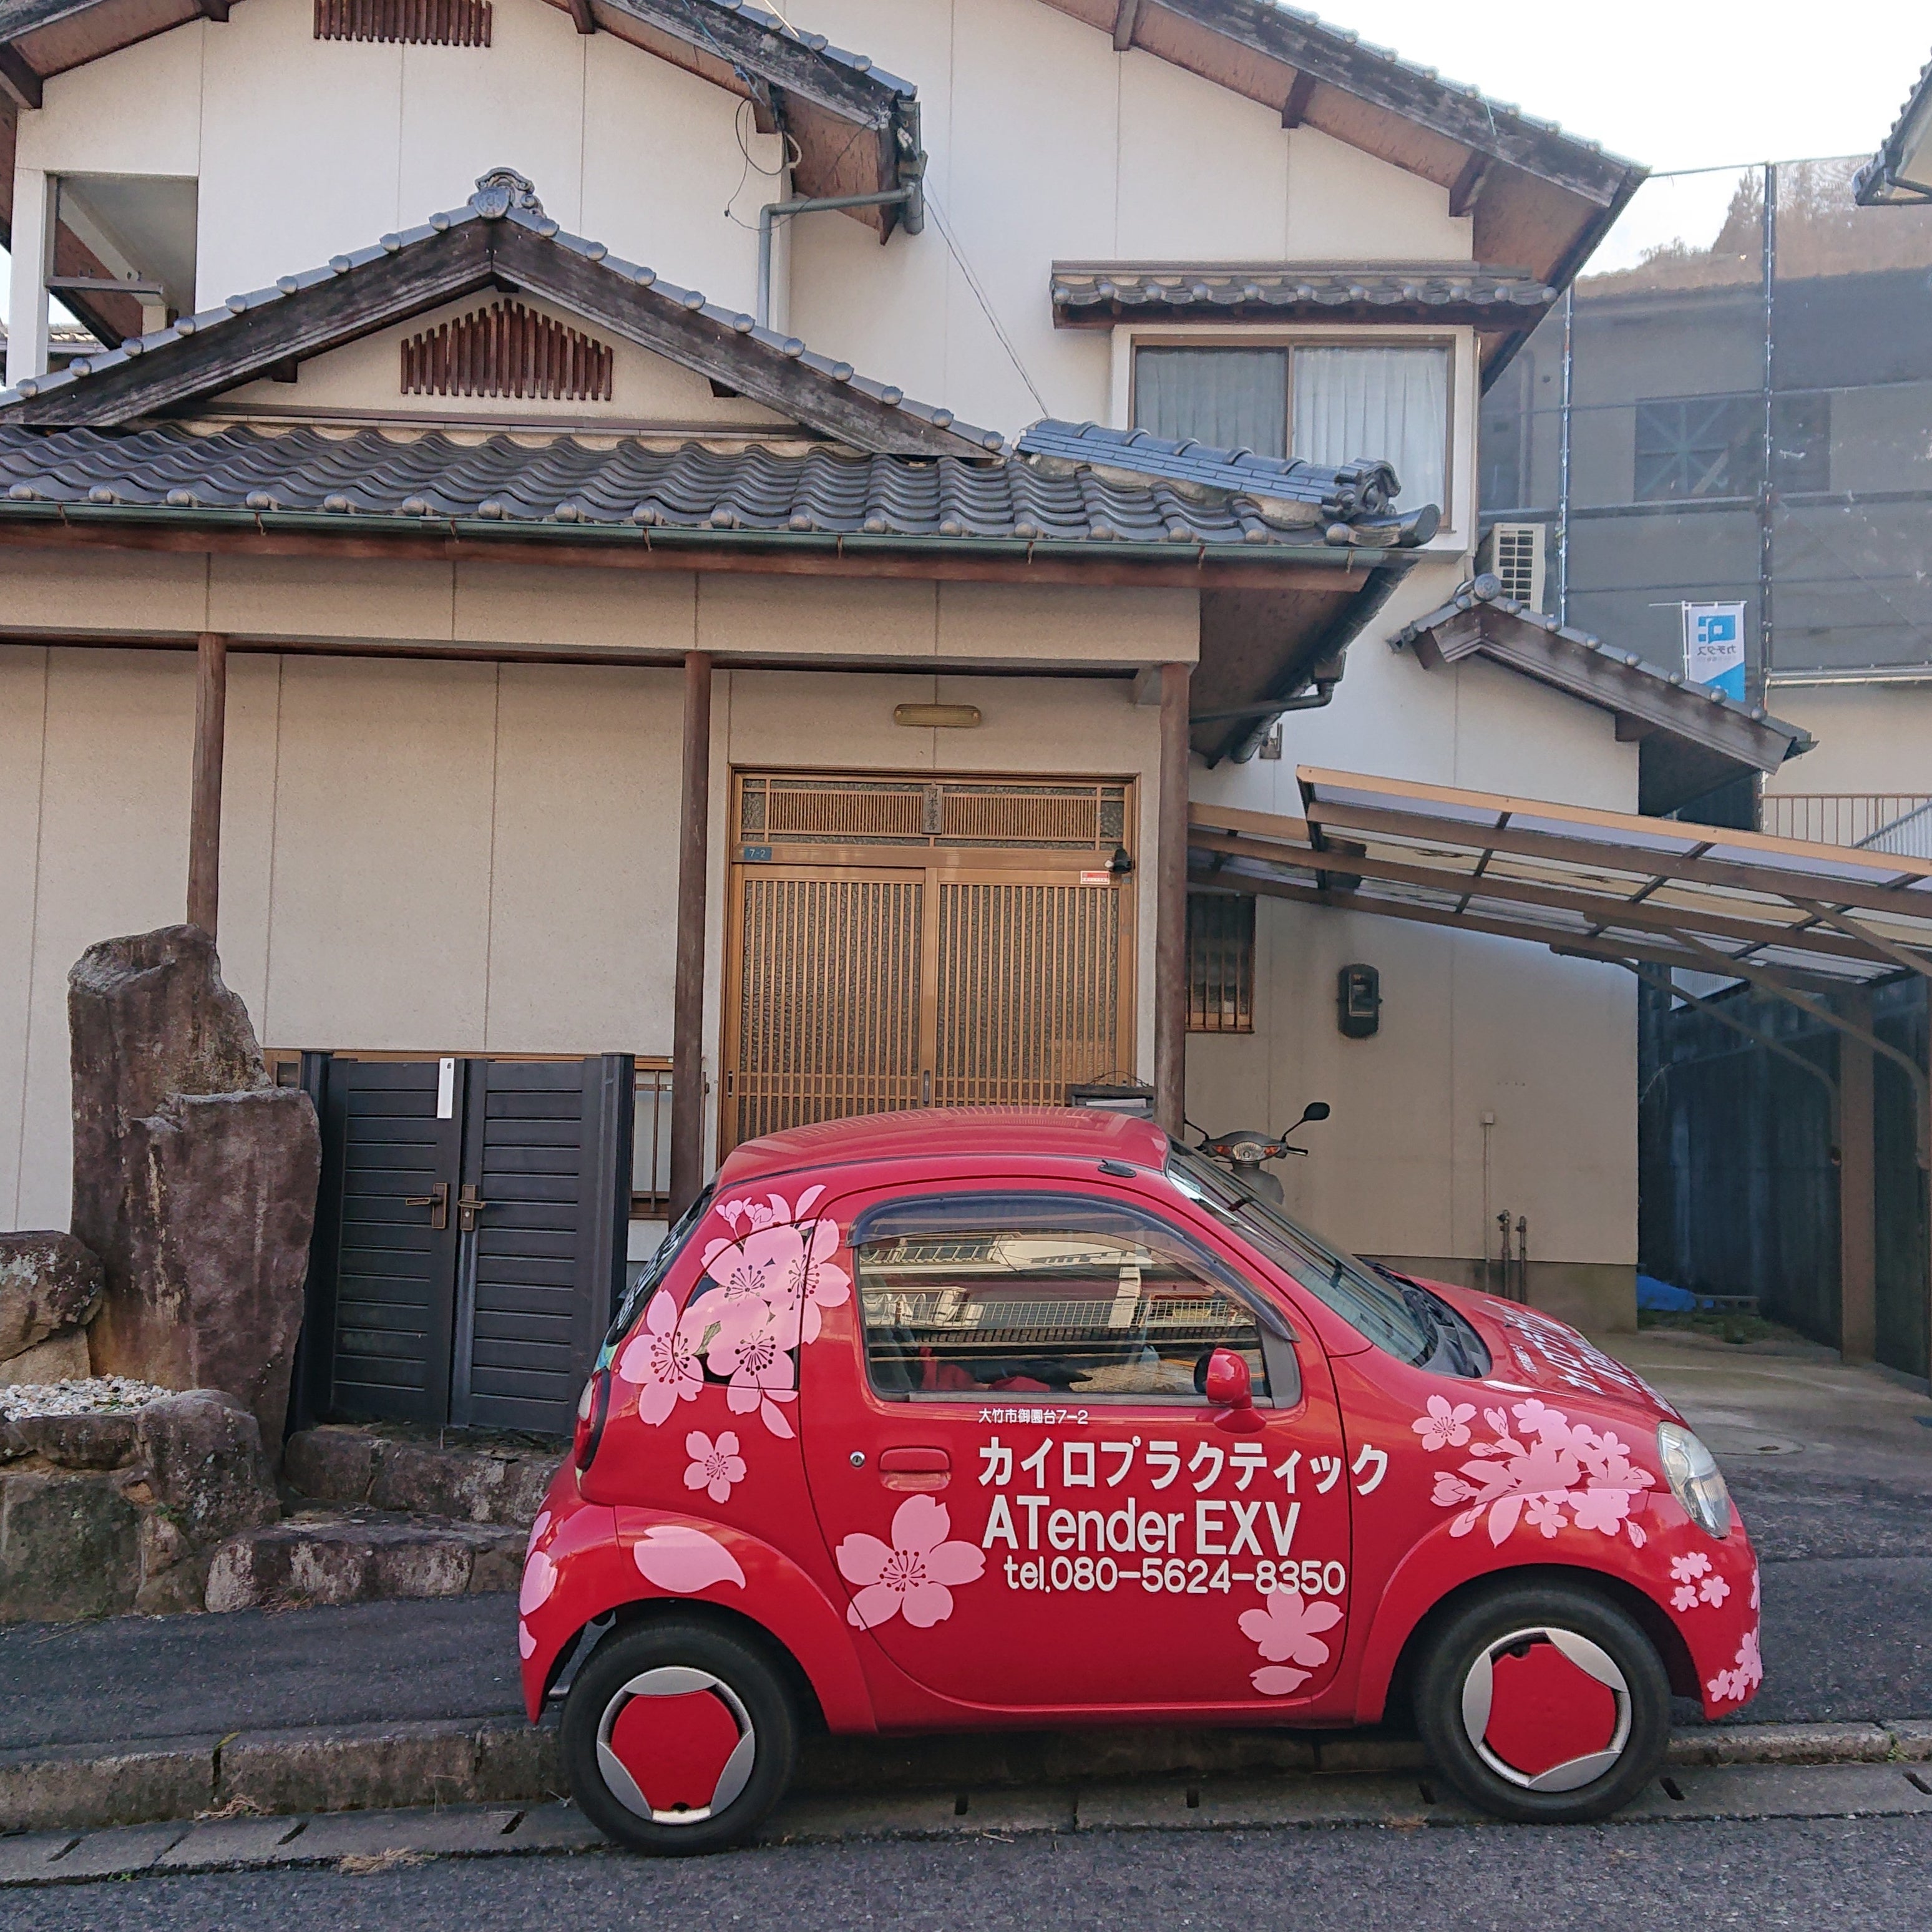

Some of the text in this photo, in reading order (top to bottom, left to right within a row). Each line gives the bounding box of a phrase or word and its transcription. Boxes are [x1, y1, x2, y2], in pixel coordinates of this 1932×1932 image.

[749, 849, 766, 857] 7-2
[978, 1435, 1388, 1496] カイロプラクティック
[982, 1495, 1301, 1556] ATender EXV
[1003, 1555, 1345, 1595] tel.080-5624-8350
